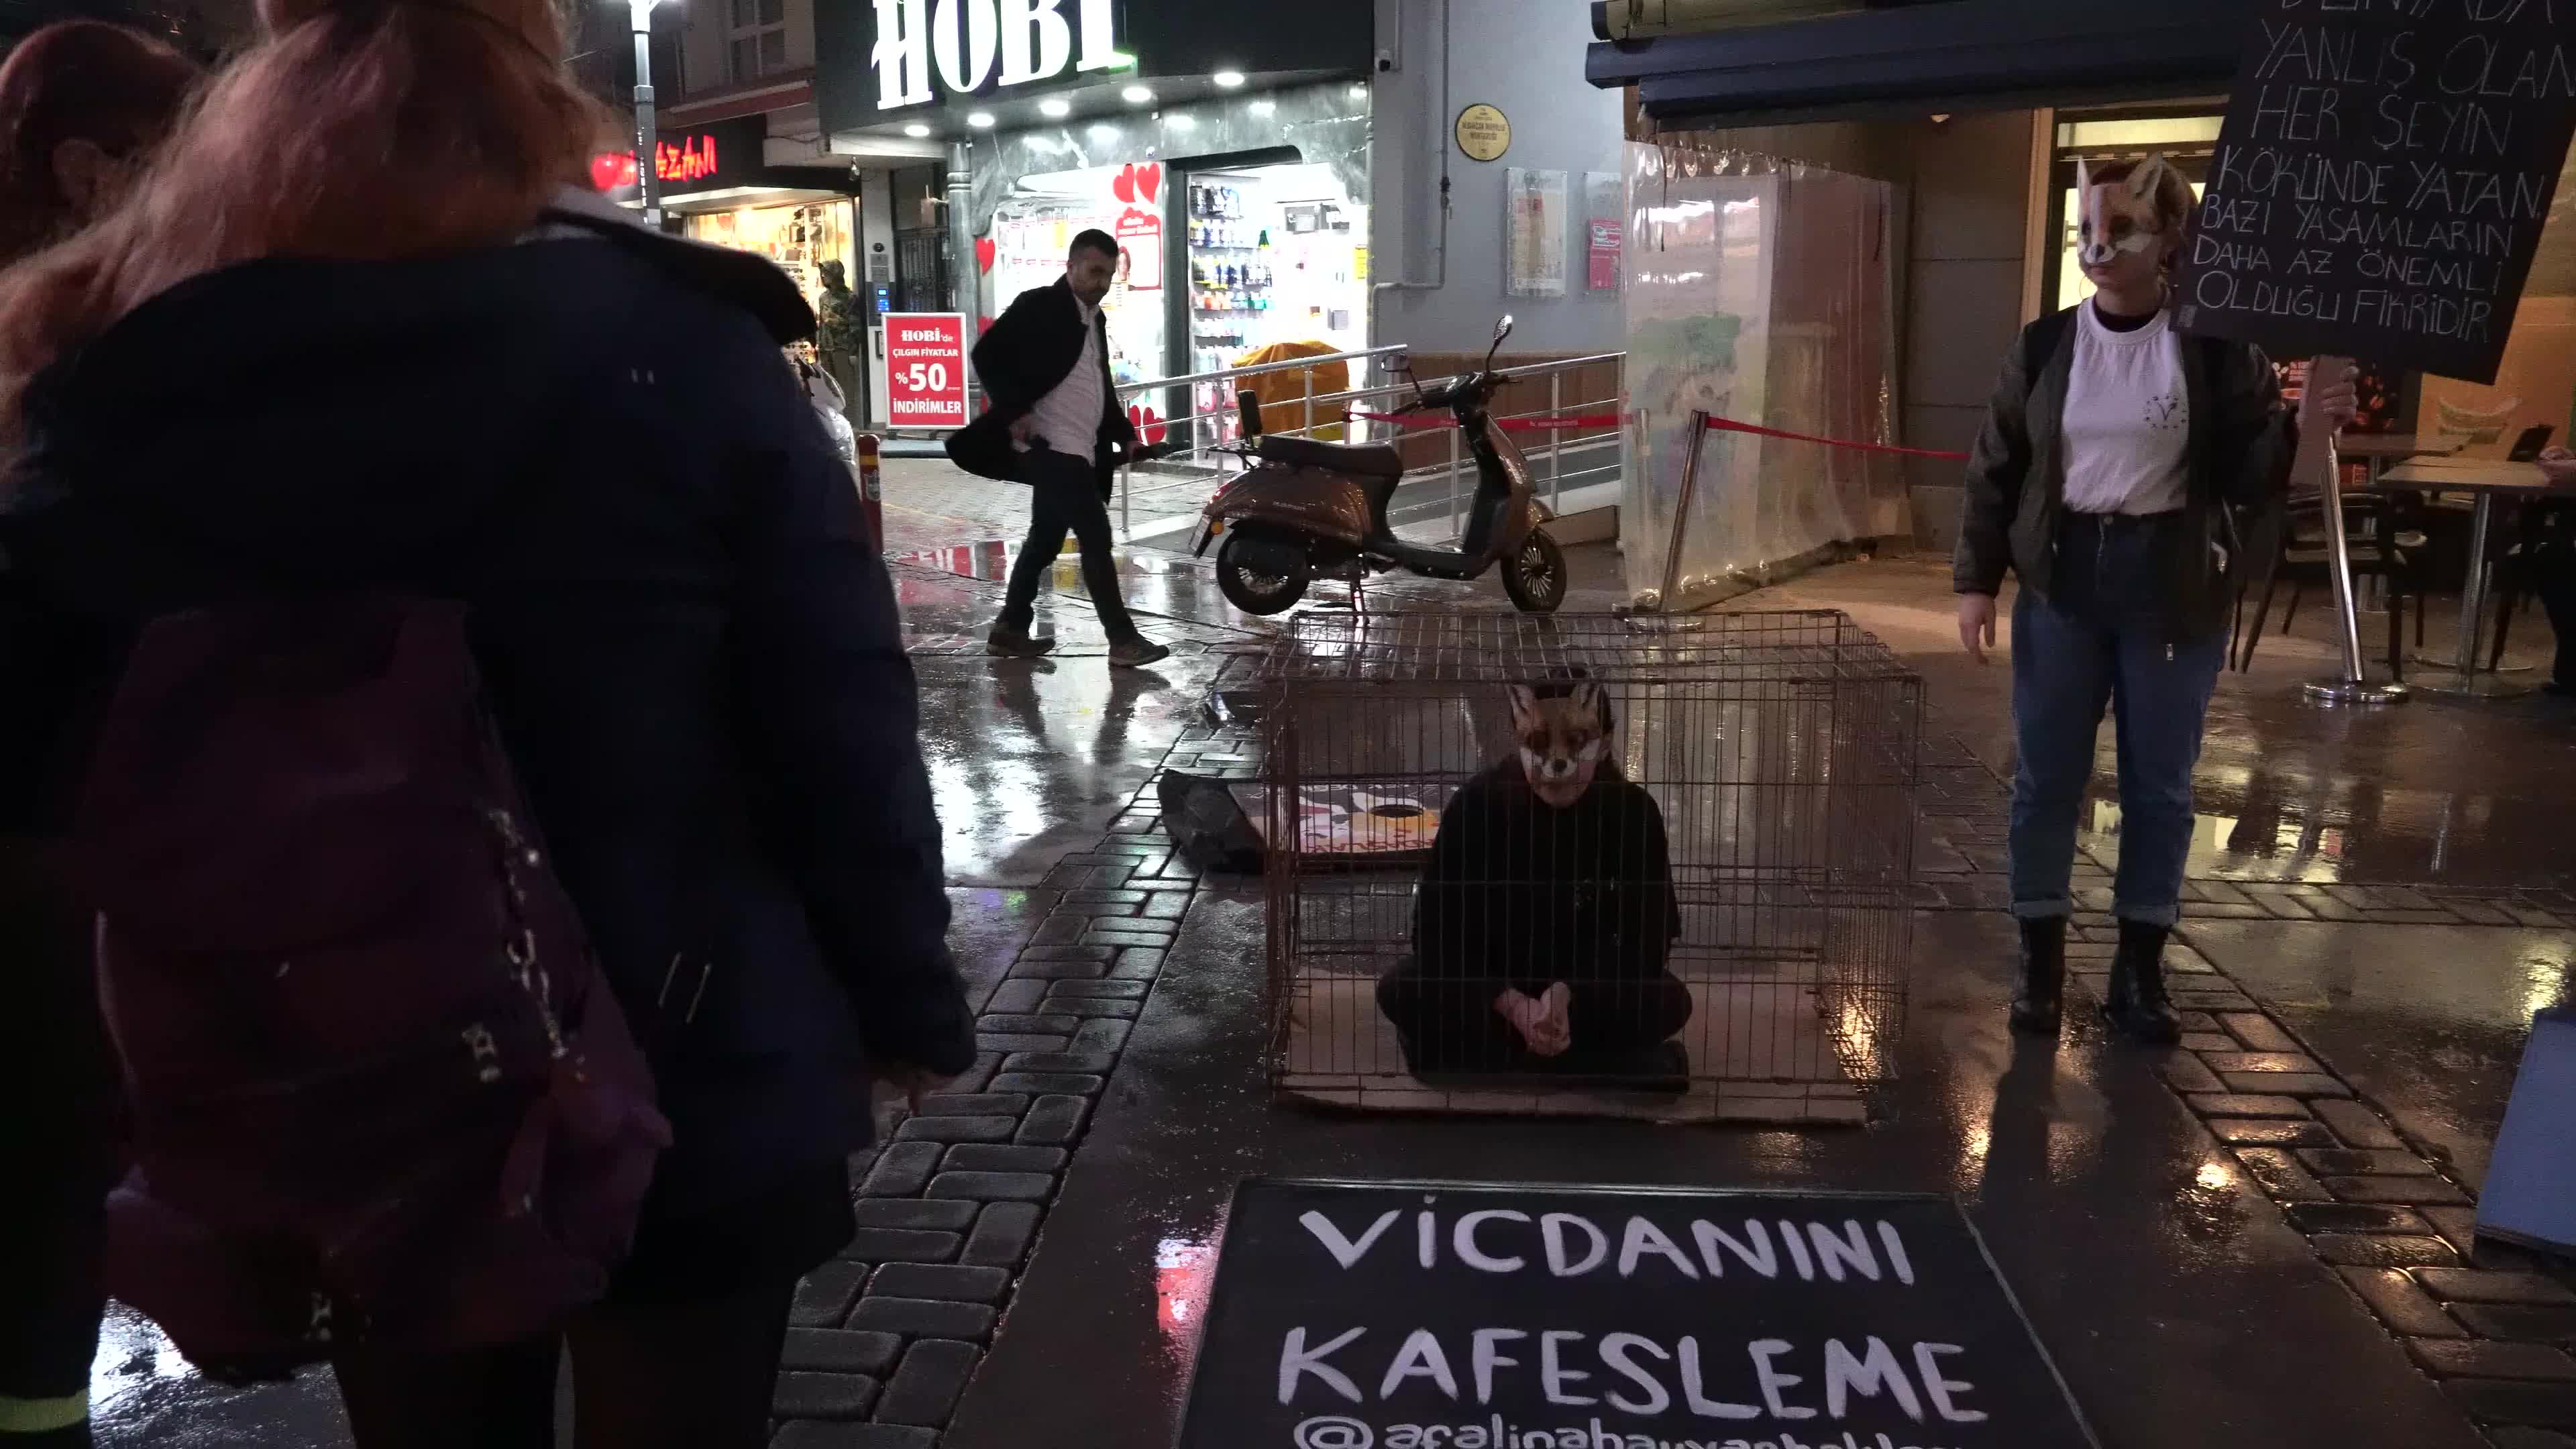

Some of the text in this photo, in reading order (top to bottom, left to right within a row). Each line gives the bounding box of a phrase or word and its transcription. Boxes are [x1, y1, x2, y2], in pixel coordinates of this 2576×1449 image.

[2255, 18, 2575, 99] YANLIŞ OLAN
[2251, 85, 2340, 140] HER
[2217, 145, 2544, 220] KÖKÜNDE YATAN
[2201, 194, 2513, 258] BAZI YAŞAMLARIN
[2193, 234, 2502, 295] DAHA AZ ÖNEMLİ
[2197, 270, 2341, 322] OLDUĞU
[892, 347, 959, 358] ÇILGIN FİYATLAR
[893, 398, 963, 414] İNDİRİMLER
[1299, 1195, 1915, 1285] VİCDANINI
[1278, 1327, 1990, 1423] KAFESLEME
